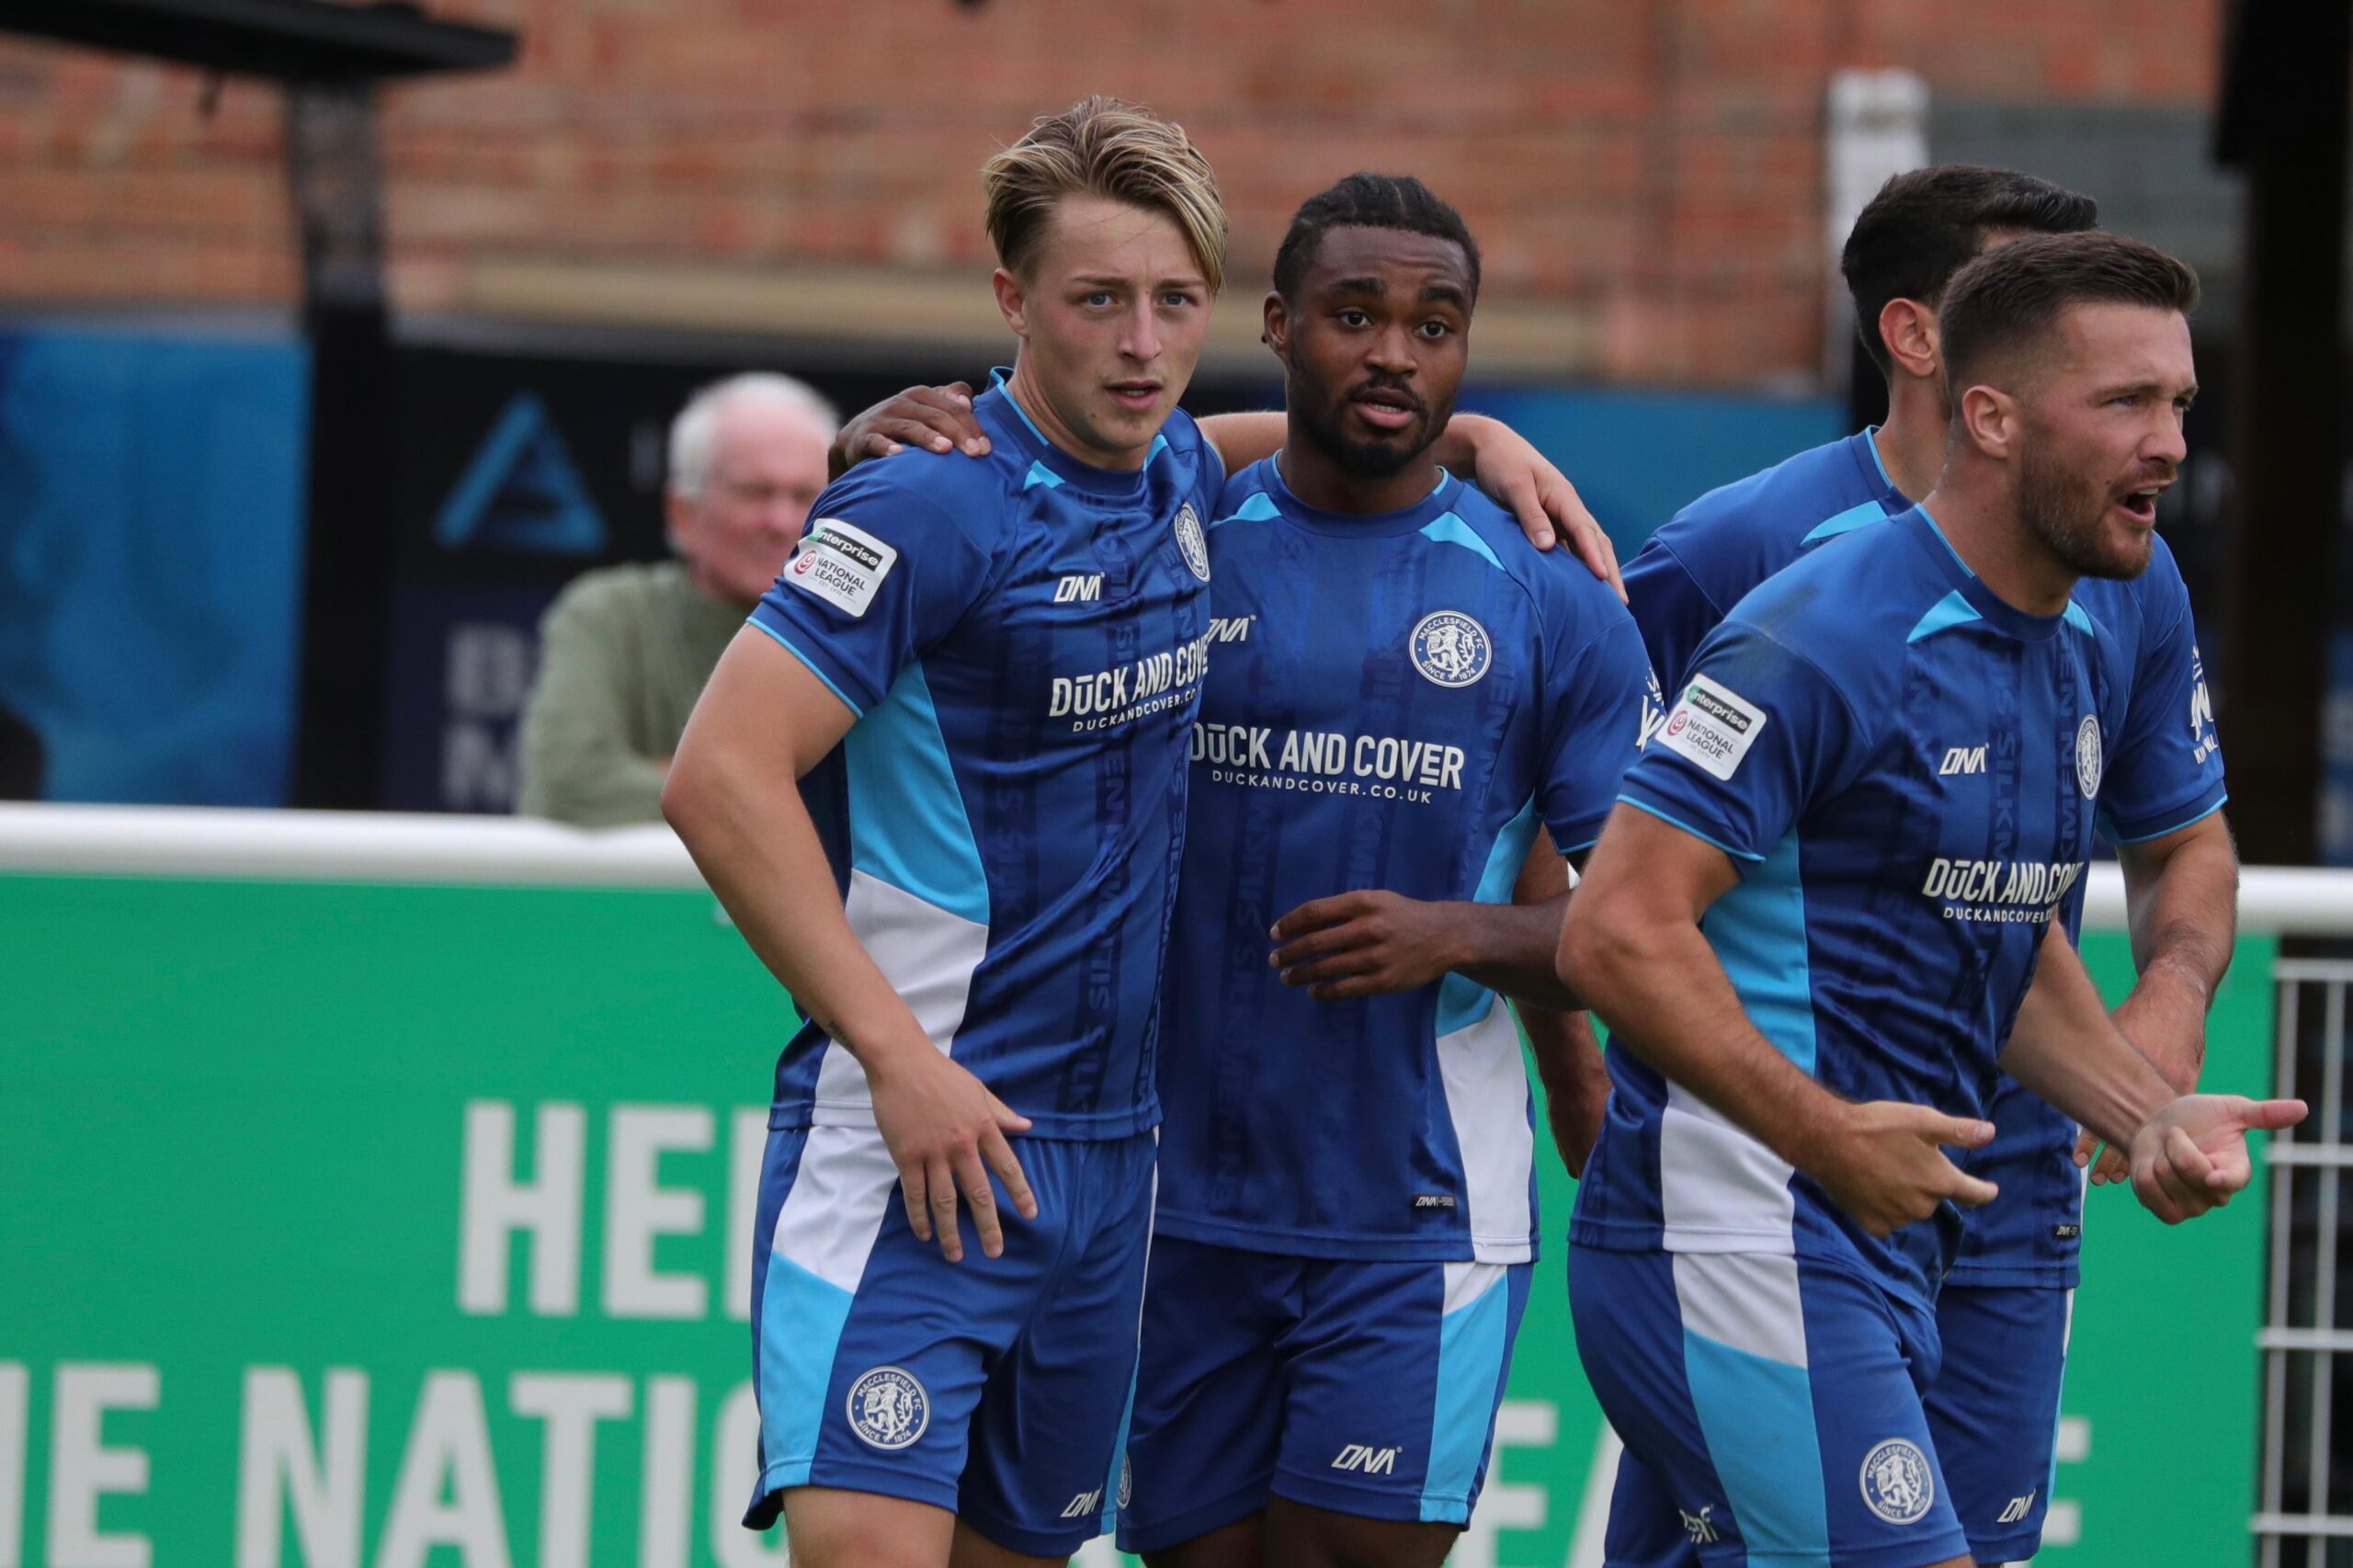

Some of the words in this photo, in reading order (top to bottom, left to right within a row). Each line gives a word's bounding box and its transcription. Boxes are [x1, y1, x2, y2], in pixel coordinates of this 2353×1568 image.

[814, 568, 856, 596] LEAGUE
[817, 558, 866, 590] NATIONAL
[1053, 575, 1102, 602] DNA
[1419, 617, 1477, 641] MACCLESFIELD
[1474, 638, 1484, 650] FC
[1131, 652, 1173, 703] AND
[1176, 634, 1209, 687] COVE
[1422, 660, 1446, 680] SINCE
[1459, 667, 1477, 681] 1874
[1686, 731, 1725, 759] LEAGUE
[1688, 720, 1734, 755] NATIONAL
[1279, 730, 1347, 775] AND
[1353, 735, 1466, 790] COVER
[1938, 747, 1986, 775] DNA
[1211, 770, 1432, 804] DUCKANDCOVER.CO.UK
[1996, 861, 2047, 904] AND
[455, 1099, 770, 1321] HE
[857, 1373, 917, 1398] MACCLESFIELD
[913, 1397, 923, 1411] FC
[857, 1419, 881, 1441] SINCE
[894, 1429, 912, 1443] 1874
[233, 1364, 770, 1568] NATI
[1331, 1444, 1395, 1475] DNA
